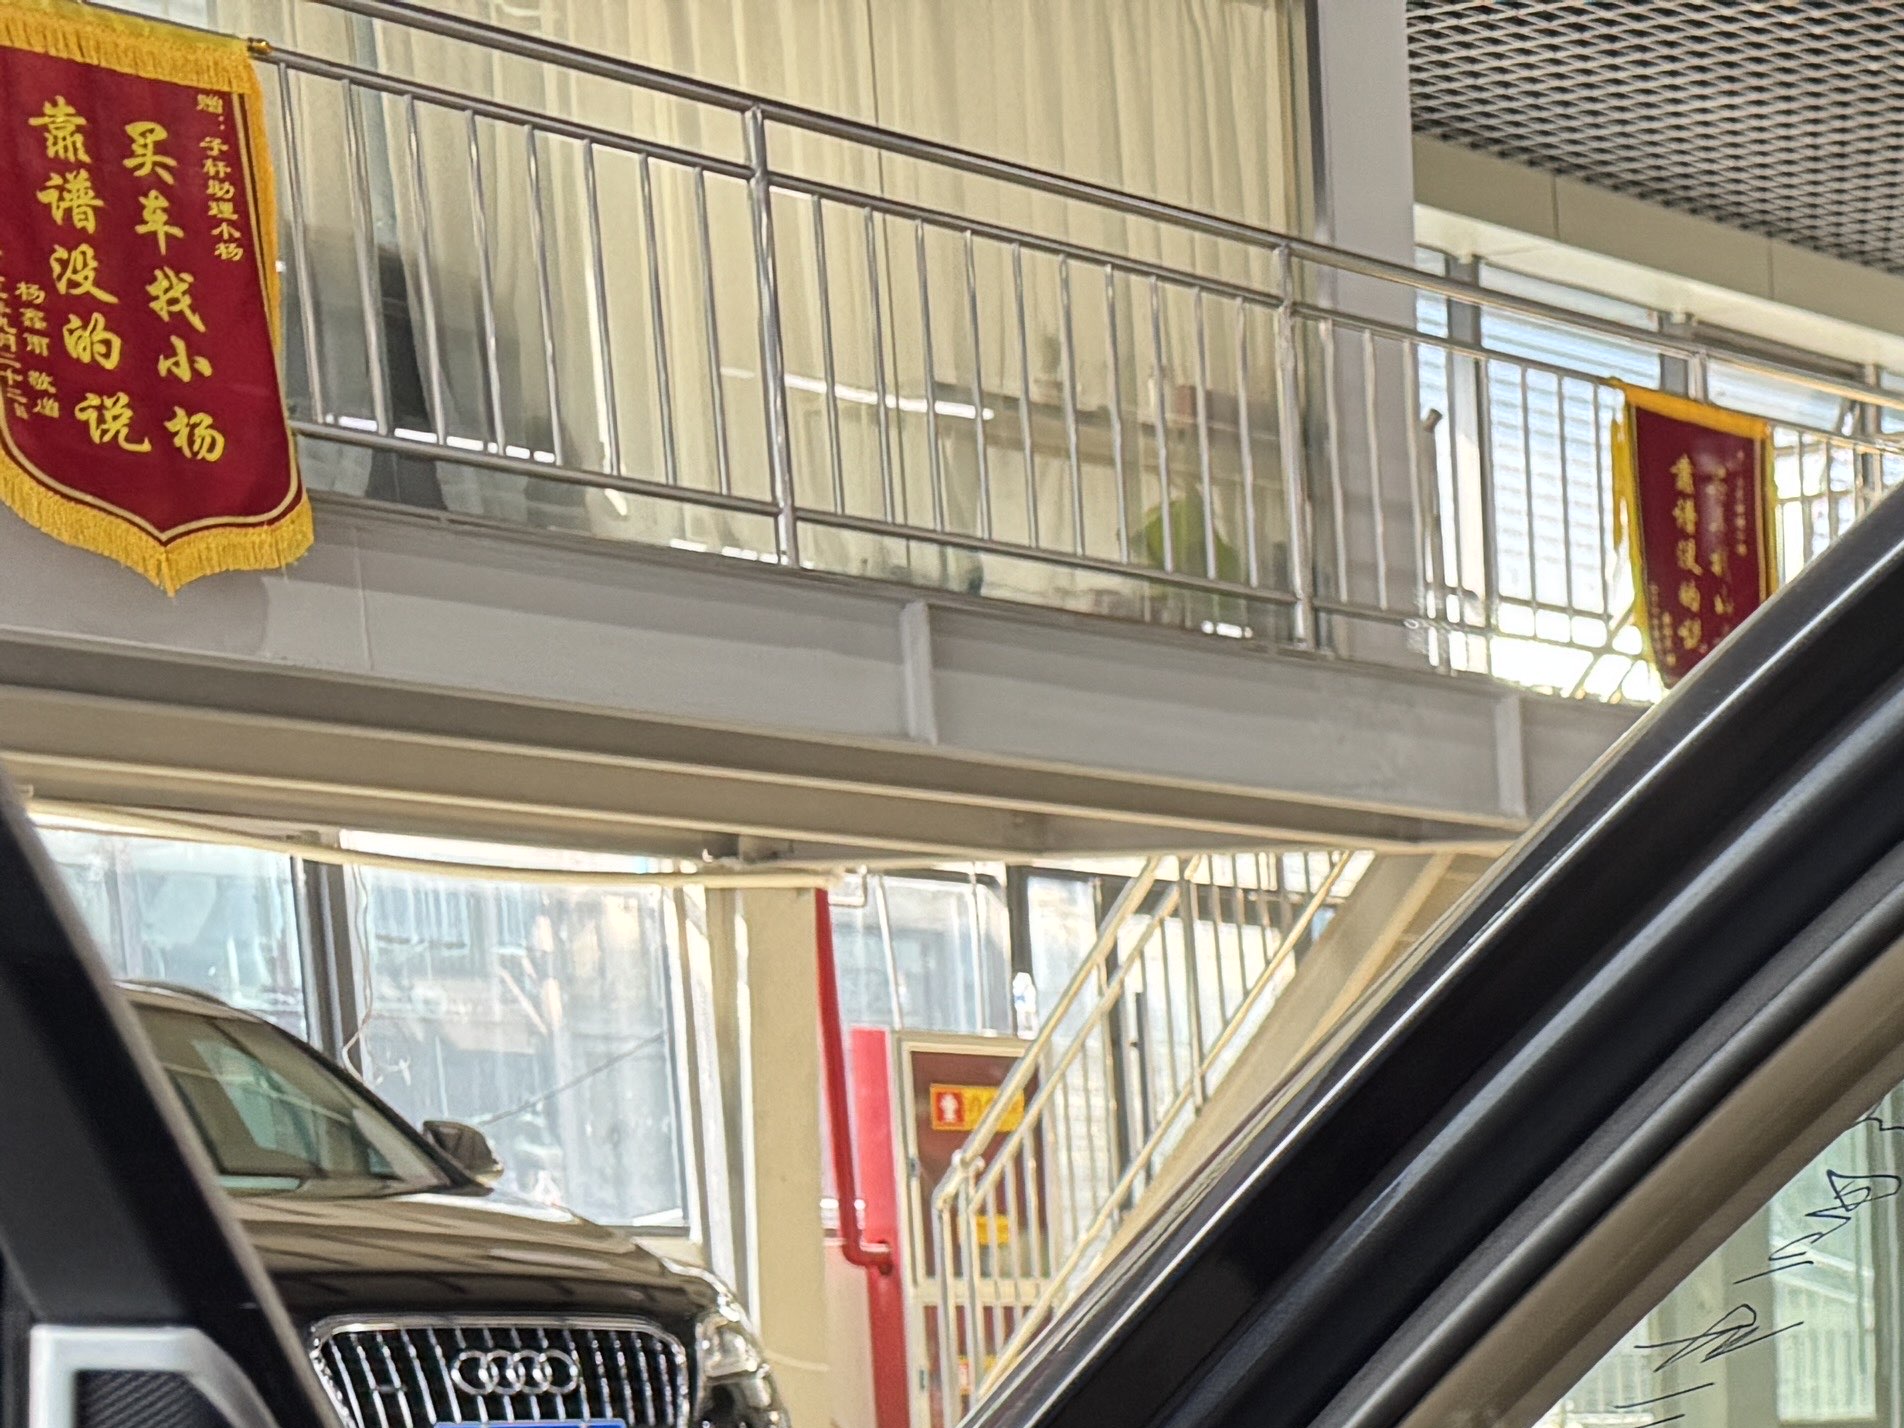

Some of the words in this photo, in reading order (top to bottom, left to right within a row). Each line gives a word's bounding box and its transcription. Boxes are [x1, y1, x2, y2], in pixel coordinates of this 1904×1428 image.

[27, 95, 152, 455] 靠谱没的说
[122, 121, 226, 463] 买车找小杨
